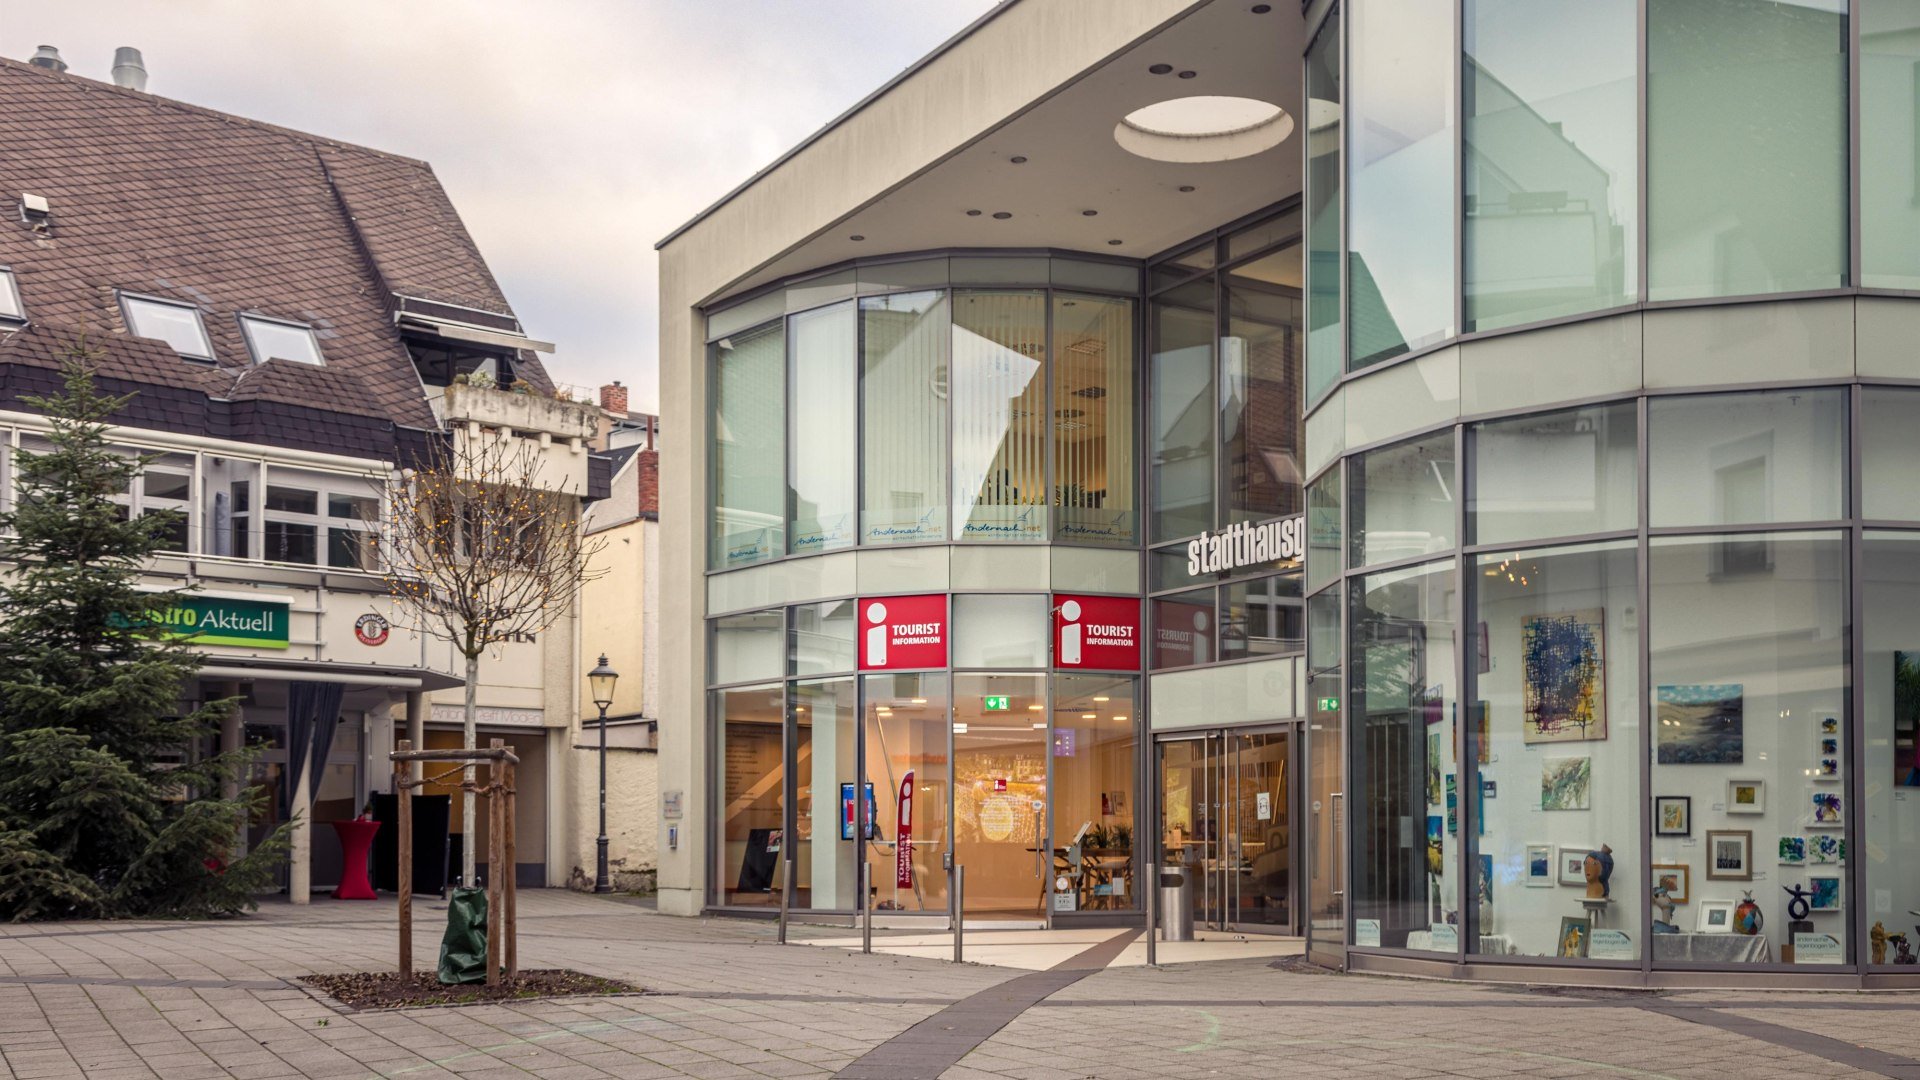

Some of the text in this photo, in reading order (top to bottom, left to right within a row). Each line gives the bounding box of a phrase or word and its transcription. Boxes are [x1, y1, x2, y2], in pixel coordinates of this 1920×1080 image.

[199, 609, 274, 632] Aktuell
[892, 623, 941, 636] TOURIST
[1086, 624, 1134, 638] TOURIST
[892, 636, 941, 646] INFORMATION
[1086, 637, 1134, 647] INFORMATION
[898, 833, 906, 882] TOURIST
